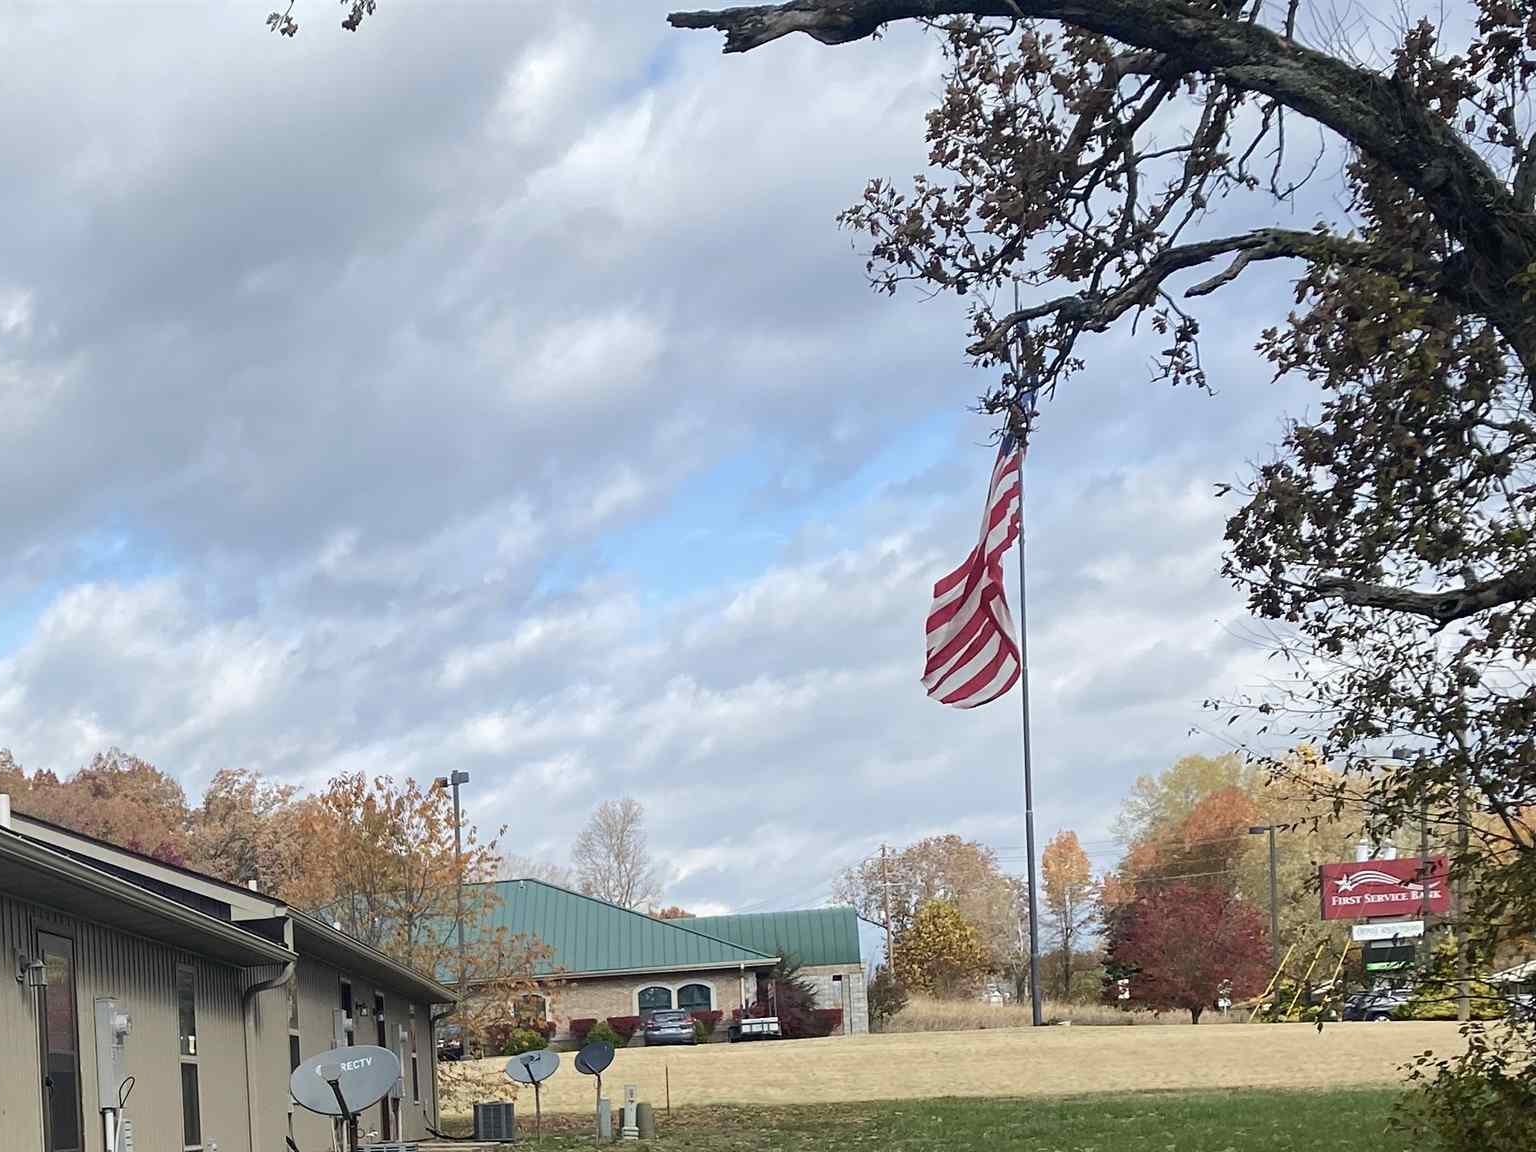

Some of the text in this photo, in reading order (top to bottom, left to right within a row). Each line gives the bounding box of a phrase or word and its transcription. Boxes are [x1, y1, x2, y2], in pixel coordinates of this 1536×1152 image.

[1331, 895, 1362, 906] FIRST
[1364, 892, 1408, 903] SERVICE
[340, 1057, 373, 1072] RECTV
